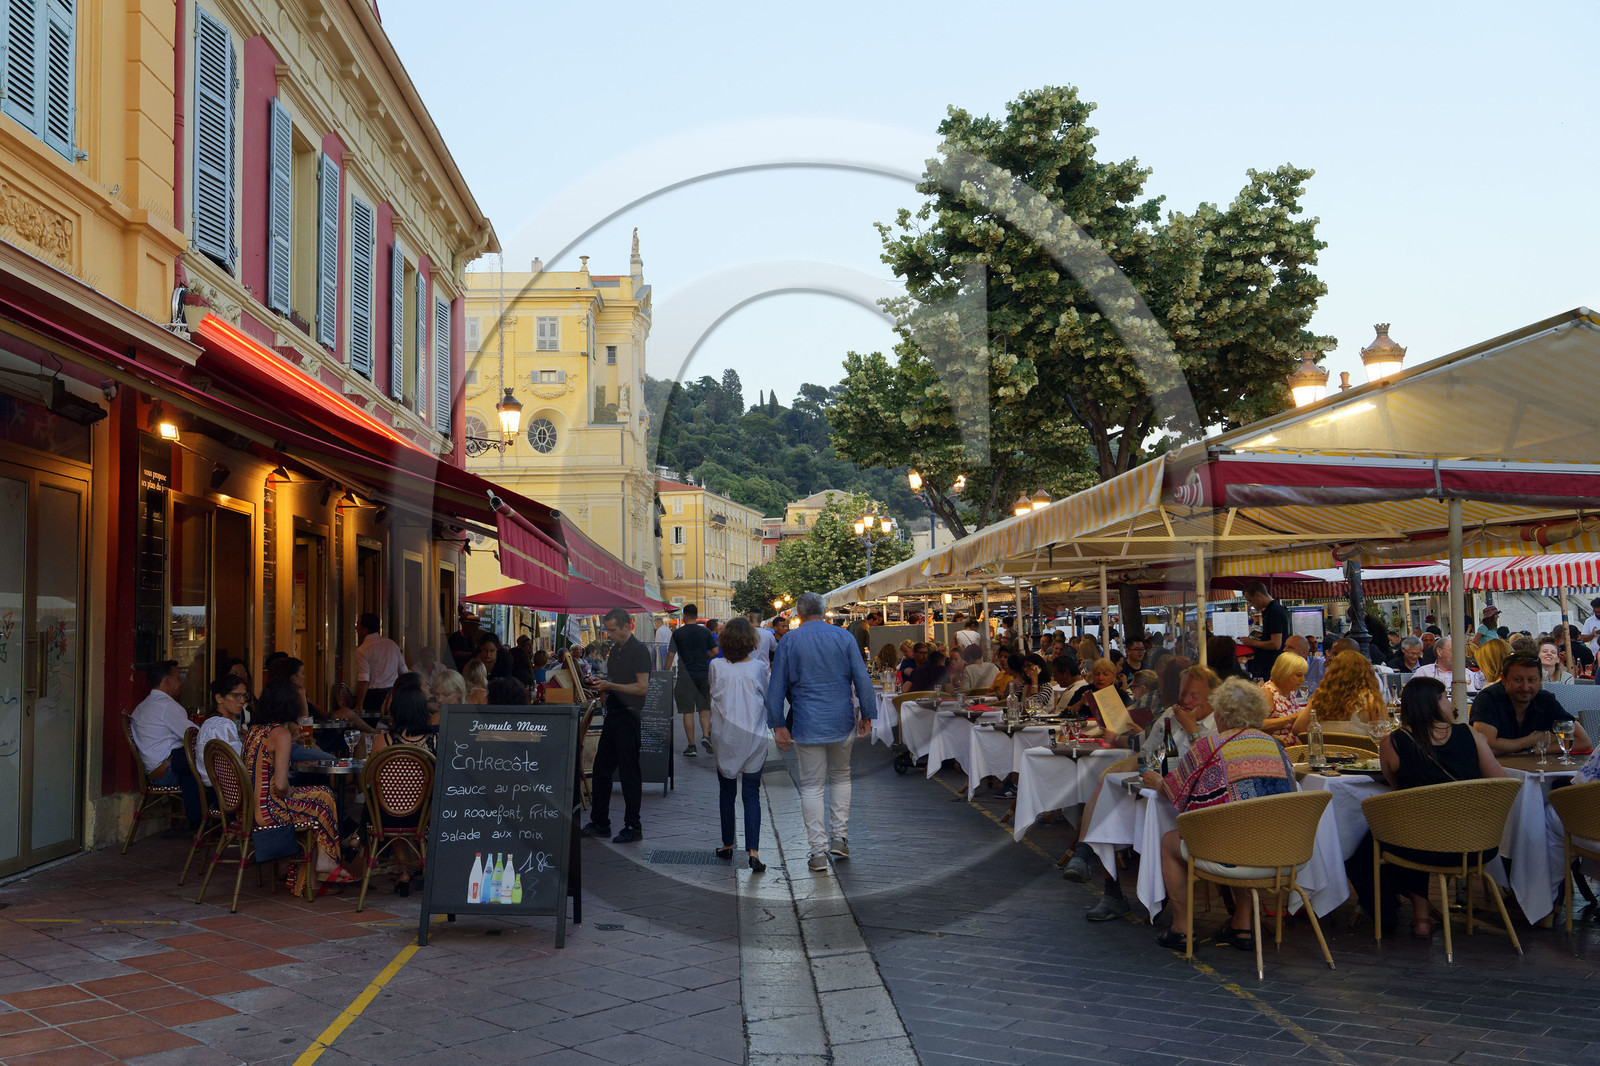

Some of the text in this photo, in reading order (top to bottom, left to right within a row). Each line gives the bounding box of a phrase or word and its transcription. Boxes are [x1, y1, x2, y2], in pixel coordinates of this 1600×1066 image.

[469, 720, 548, 732] Formule Menu
[451, 740, 540, 772] Entrecôte
[445, 783, 554, 801] sauce au poivre
[442, 809, 458, 819] ou
[439, 827, 481, 843] salade
[491, 830, 512, 840] aux
[518, 850, 556, 874] 18€
